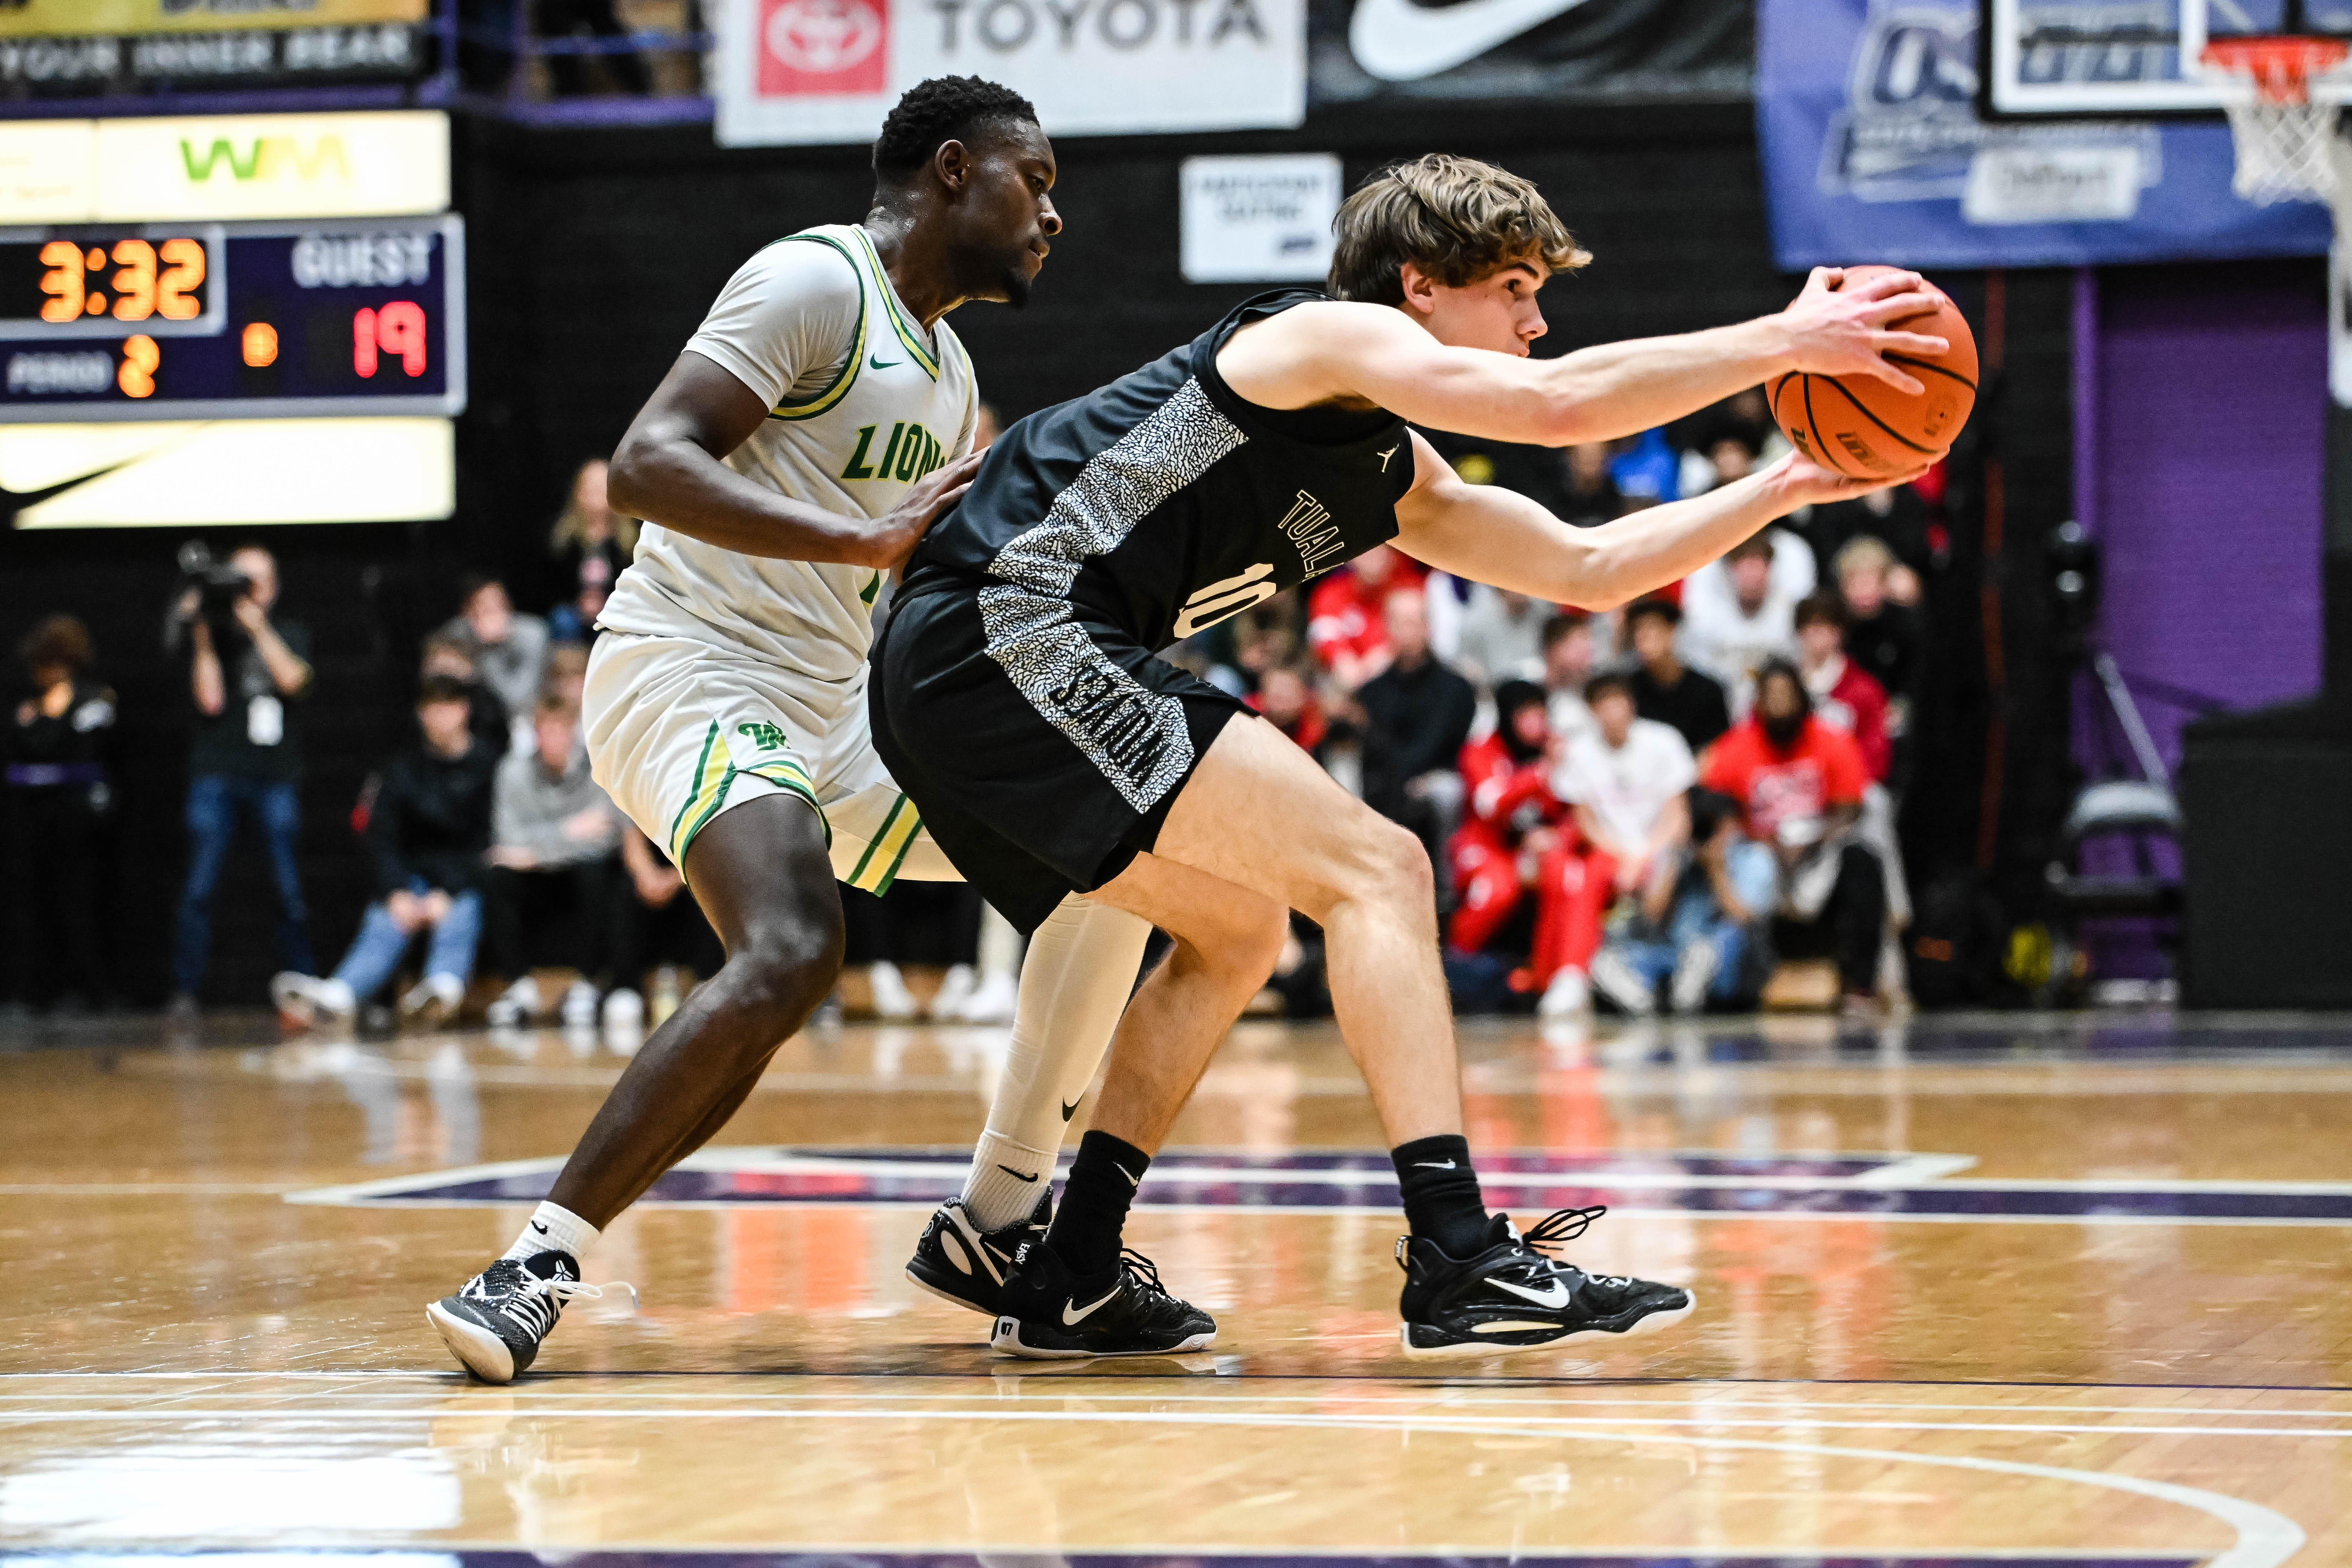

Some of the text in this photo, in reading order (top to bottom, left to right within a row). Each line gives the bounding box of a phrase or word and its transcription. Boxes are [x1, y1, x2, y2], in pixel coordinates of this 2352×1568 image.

[132, 33, 273, 73] INNER
[284, 25, 412, 70] BEAR
[927, 0, 1273, 58] TOYOTA
[181, 137, 349, 180] WM
[40, 238, 206, 322] 3:32
[291, 234, 434, 288] GUEST
[118, 335, 159, 398] 2
[354, 301, 426, 377] 19
[7, 352, 113, 393] PERIOD
[840, 420, 946, 485] LION
[1173, 563, 1276, 639] 10
[1048, 665, 1170, 789] WOLVES
